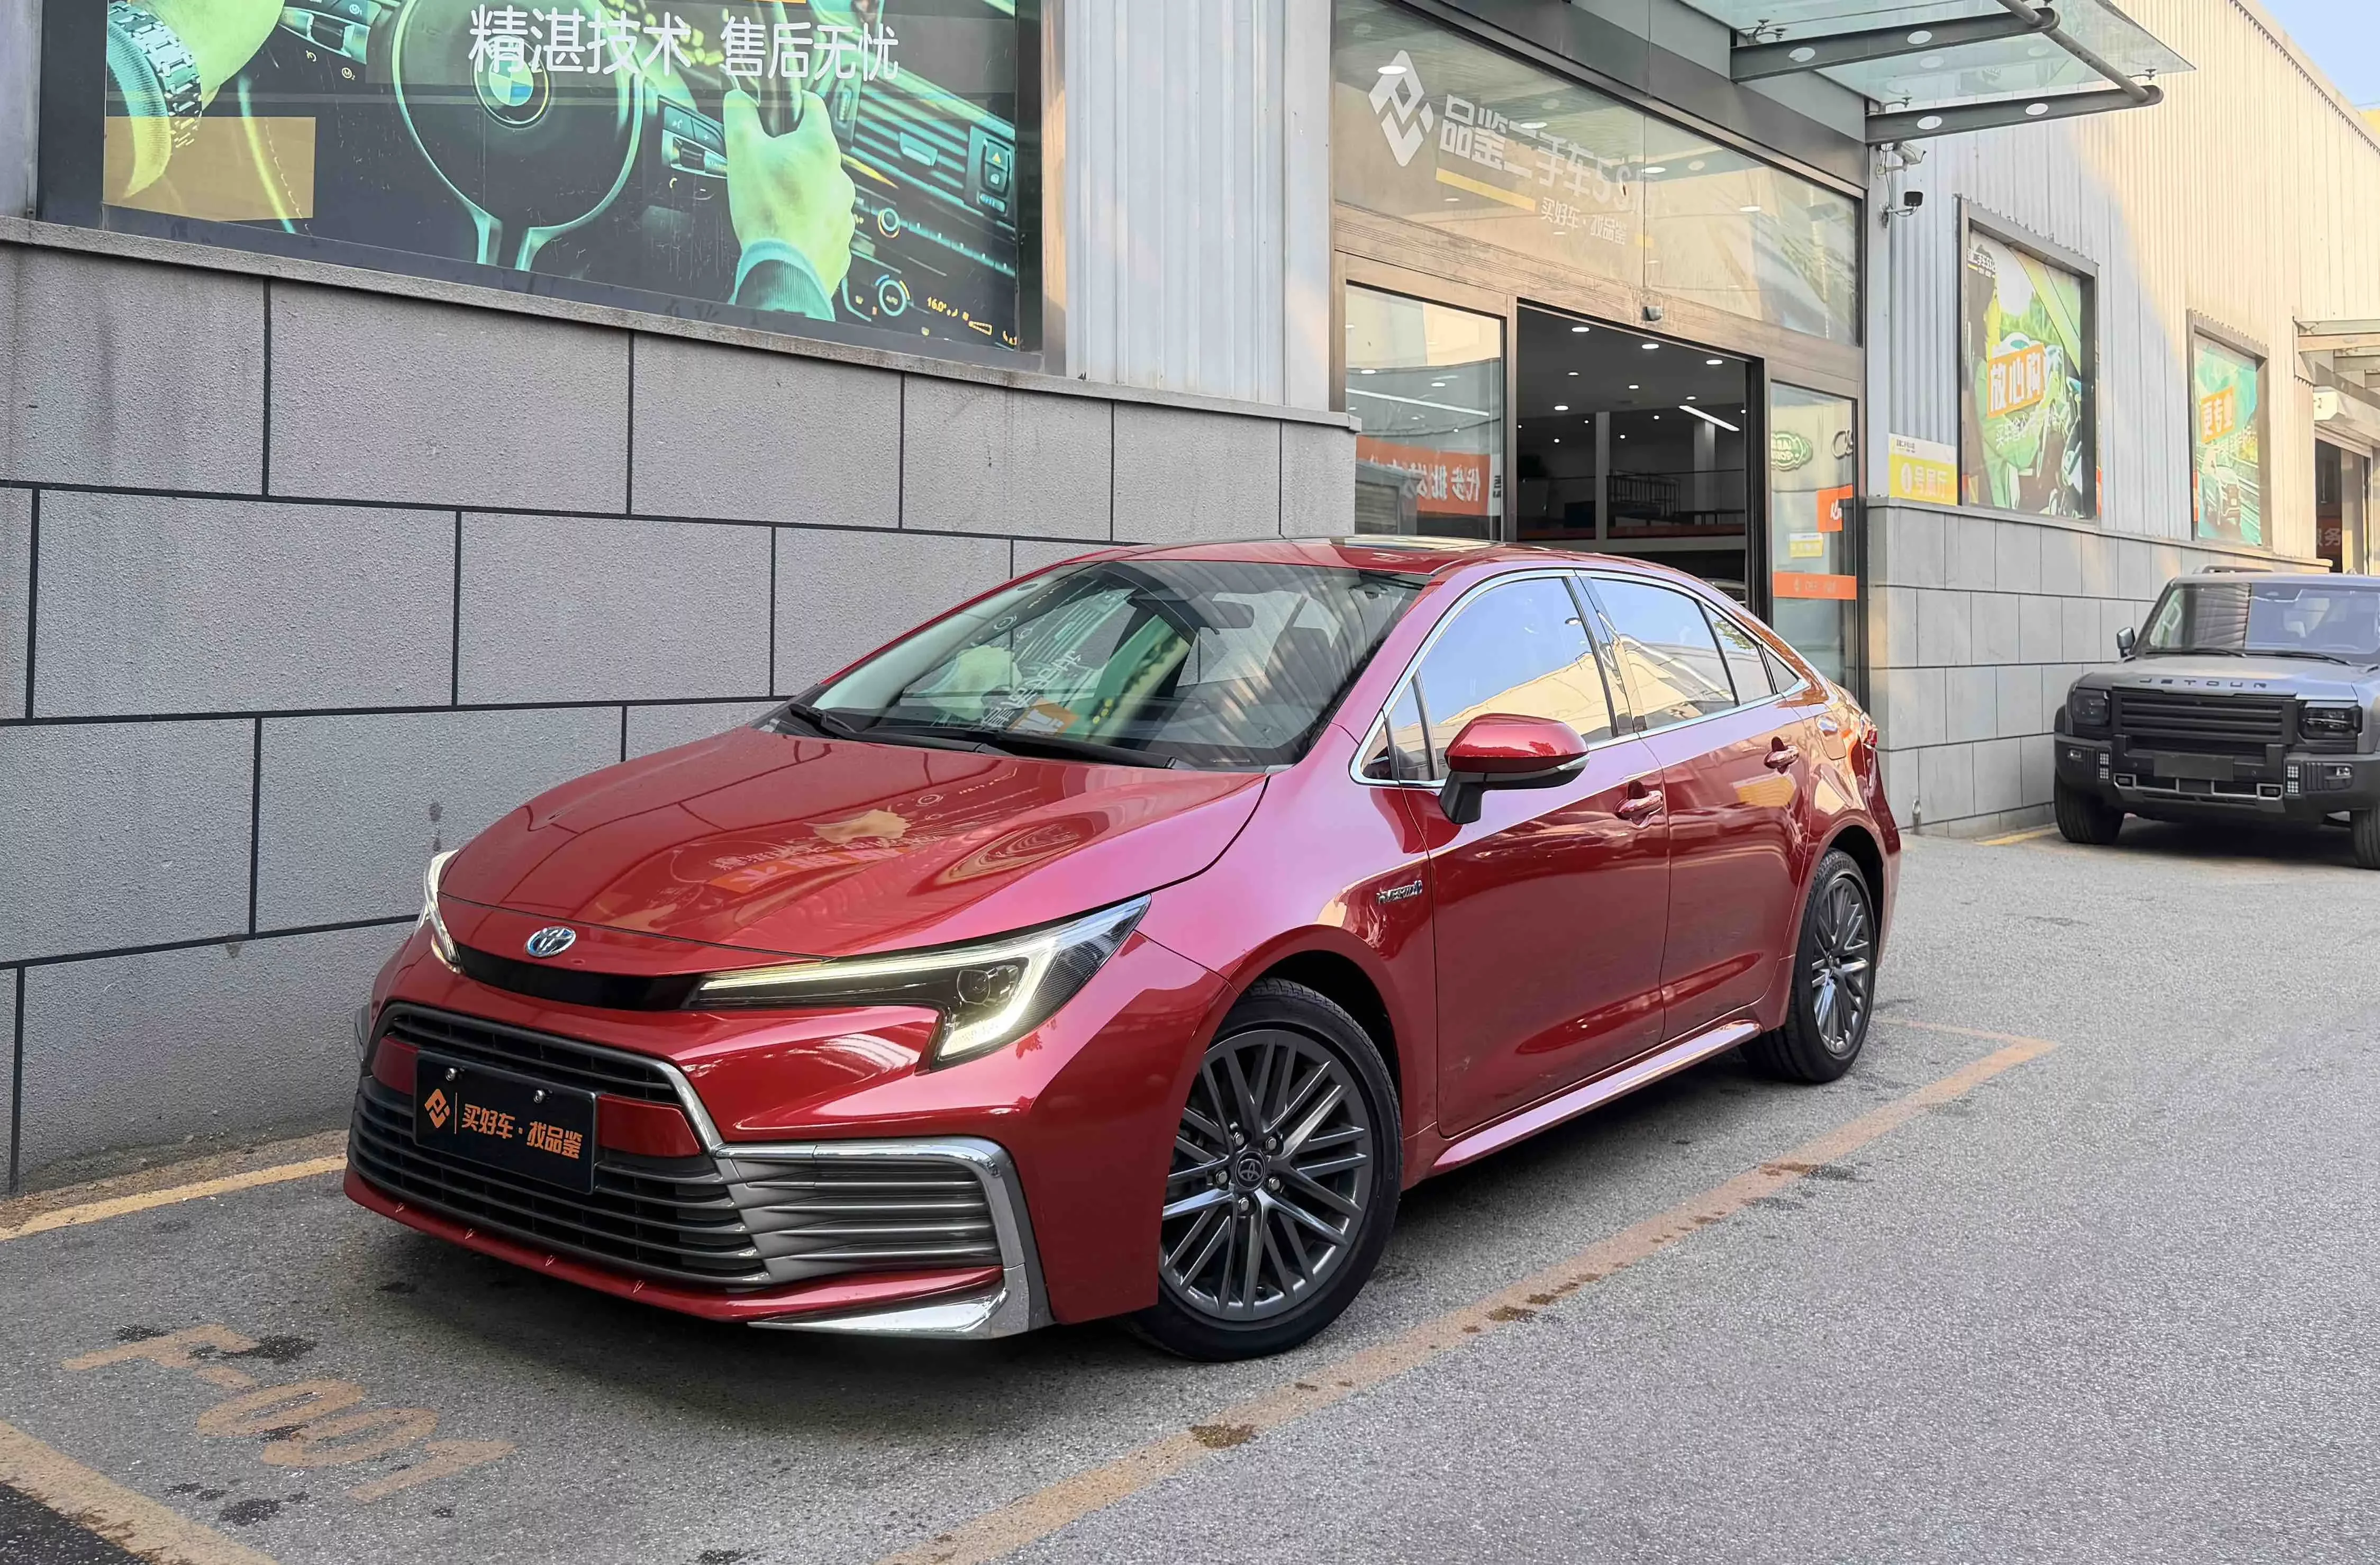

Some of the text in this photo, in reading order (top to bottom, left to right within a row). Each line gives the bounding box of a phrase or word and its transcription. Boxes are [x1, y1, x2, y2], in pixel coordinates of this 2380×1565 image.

[468, 4, 900, 82] 精湛技术 售后无忧
[1990, 351, 2040, 413] 放心购
[2139, 677, 2267, 689] JETOUR
[461, 1103, 583, 1159] 买好车·找品鉴
